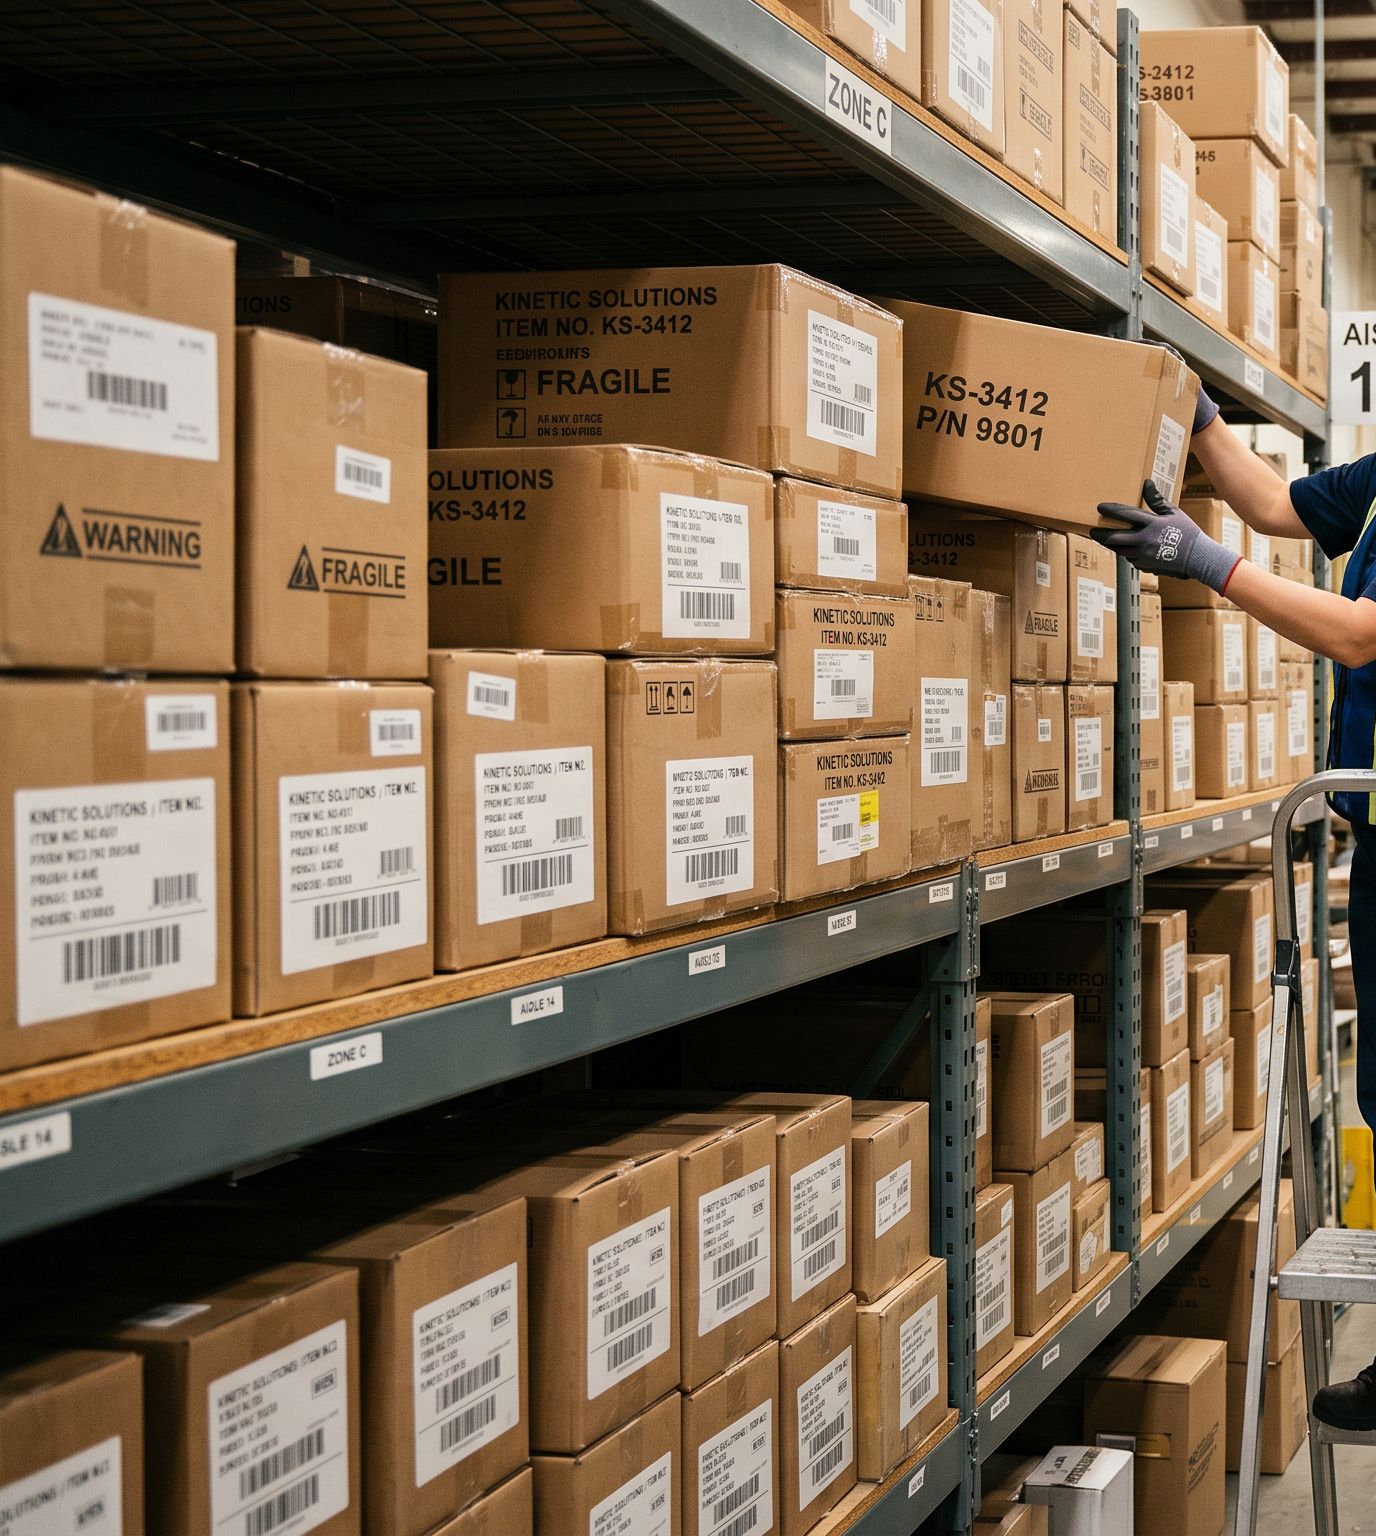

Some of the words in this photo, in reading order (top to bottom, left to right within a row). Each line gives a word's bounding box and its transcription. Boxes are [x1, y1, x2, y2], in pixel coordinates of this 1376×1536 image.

[1139, 65, 1194, 80] S-2412
[1139, 85, 1194, 101] S-3801
[828, 73, 872, 131] ZONE
[877, 107, 886, 138] C
[237, 295, 292, 314] IONS
[495, 290, 581, 311] KINETIC
[588, 286, 718, 309] SOLUTIONS
[496, 318, 549, 338] ITEM
[556, 317, 594, 337] NO.
[602, 314, 693, 336] KS-3412
[537, 367, 671, 396] FRAGILE
[924, 371, 1049, 417] KS-3412
[916, 405, 968, 437] P/N
[975, 417, 1043, 451] 9801
[427, 469, 554, 491] OLUTIONS
[428, 500, 526, 522] KS-3412
[83, 521, 201, 559] WARNING
[910, 533, 976, 547] UTIONS
[909, 552, 958, 566] S-3412
[322, 557, 406, 590] FRAGILE
[428, 557, 502, 586] GILE
[813, 608, 848, 625] KINETIC
[850, 610, 895, 627] SOLUTIONS
[821, 630, 840, 644] ITEM
[842, 631, 856, 645] NO.
[857, 632, 887, 646] KS-3412
[817, 754, 849, 771] KINETIC
[850, 751, 893, 768] SOLUTIONS
[824, 776, 842, 791] ITEM
[843, 775, 856, 789] NO.
[29, 806, 78, 825] KINETIC
[82, 801, 147, 821] SOLUTIONS
[328, 1047, 356, 1067] ZONE
[359, 1045, 367, 1058] C
[0, 1133, 28, 1157] SLE
